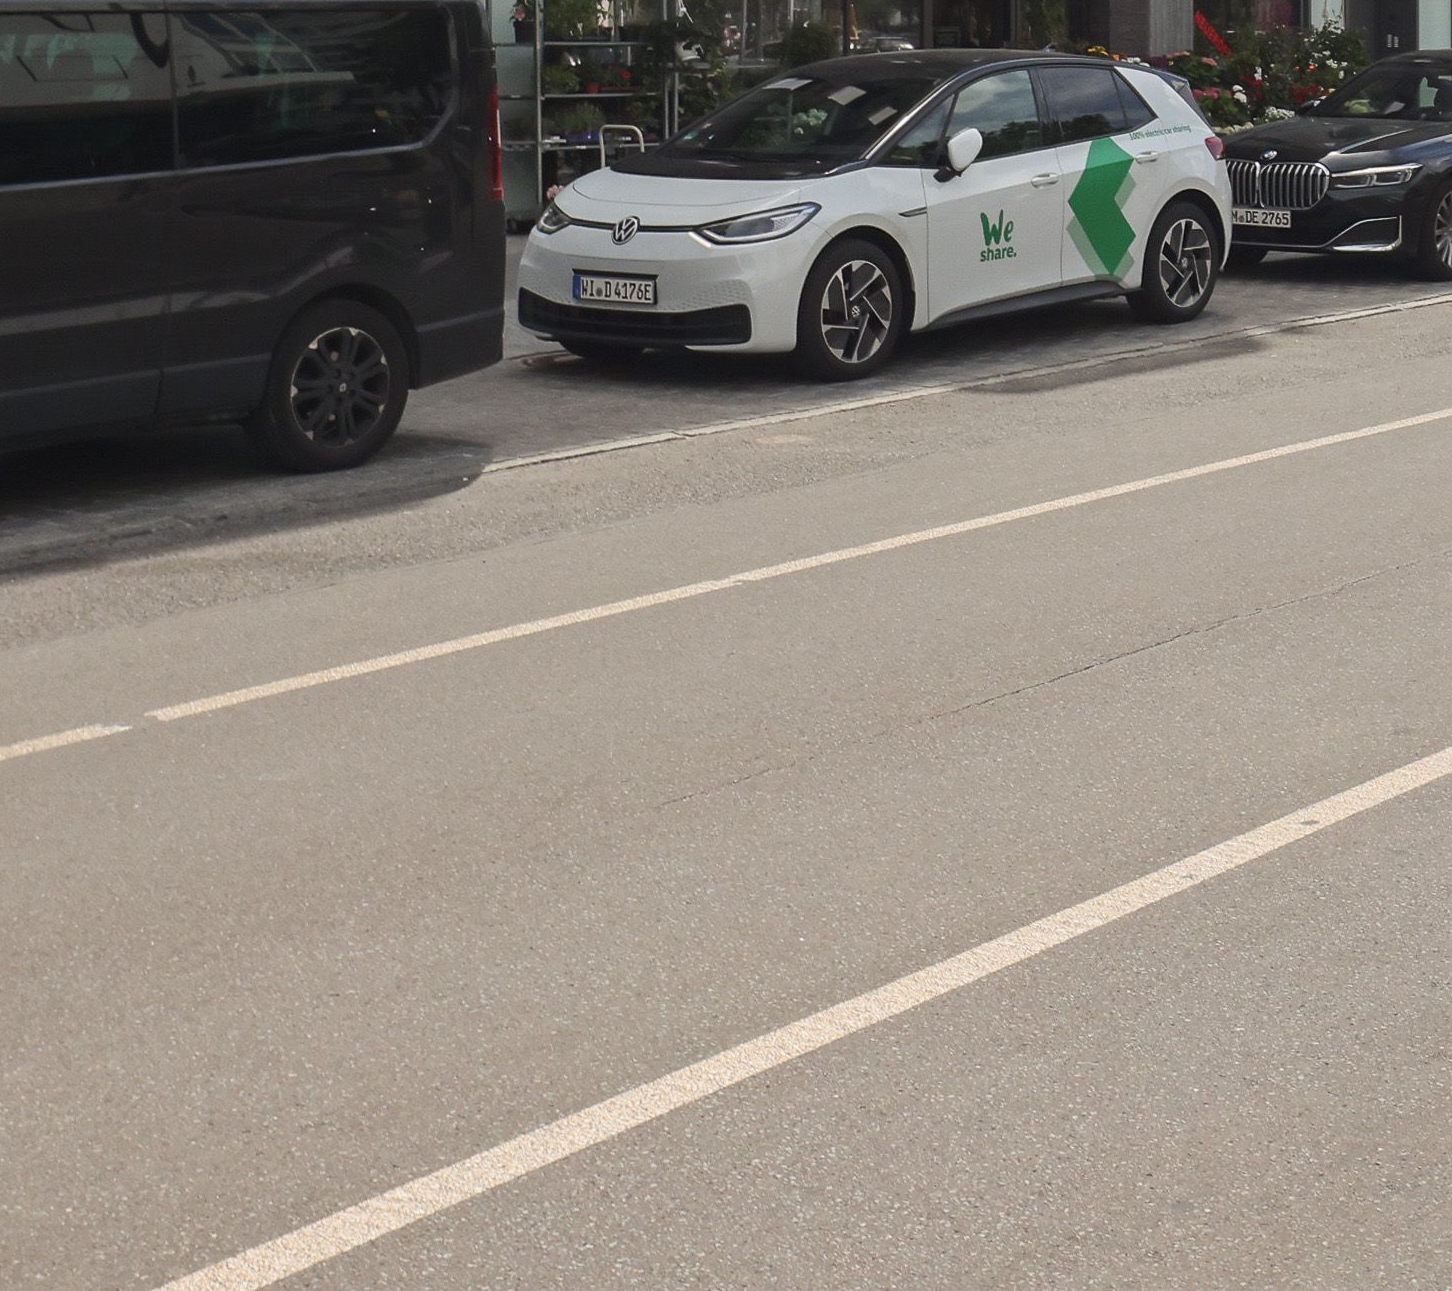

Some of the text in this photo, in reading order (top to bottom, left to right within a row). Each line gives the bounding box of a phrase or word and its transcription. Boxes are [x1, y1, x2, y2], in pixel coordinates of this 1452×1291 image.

[1245, 210, 1259, 224] DE
[1261, 211, 1289, 226] 2765
[980, 208, 1014, 247] We
[979, 246, 1017, 263] share.
[604, 281, 612, 298] D
[614, 281, 652, 301] 4176E
